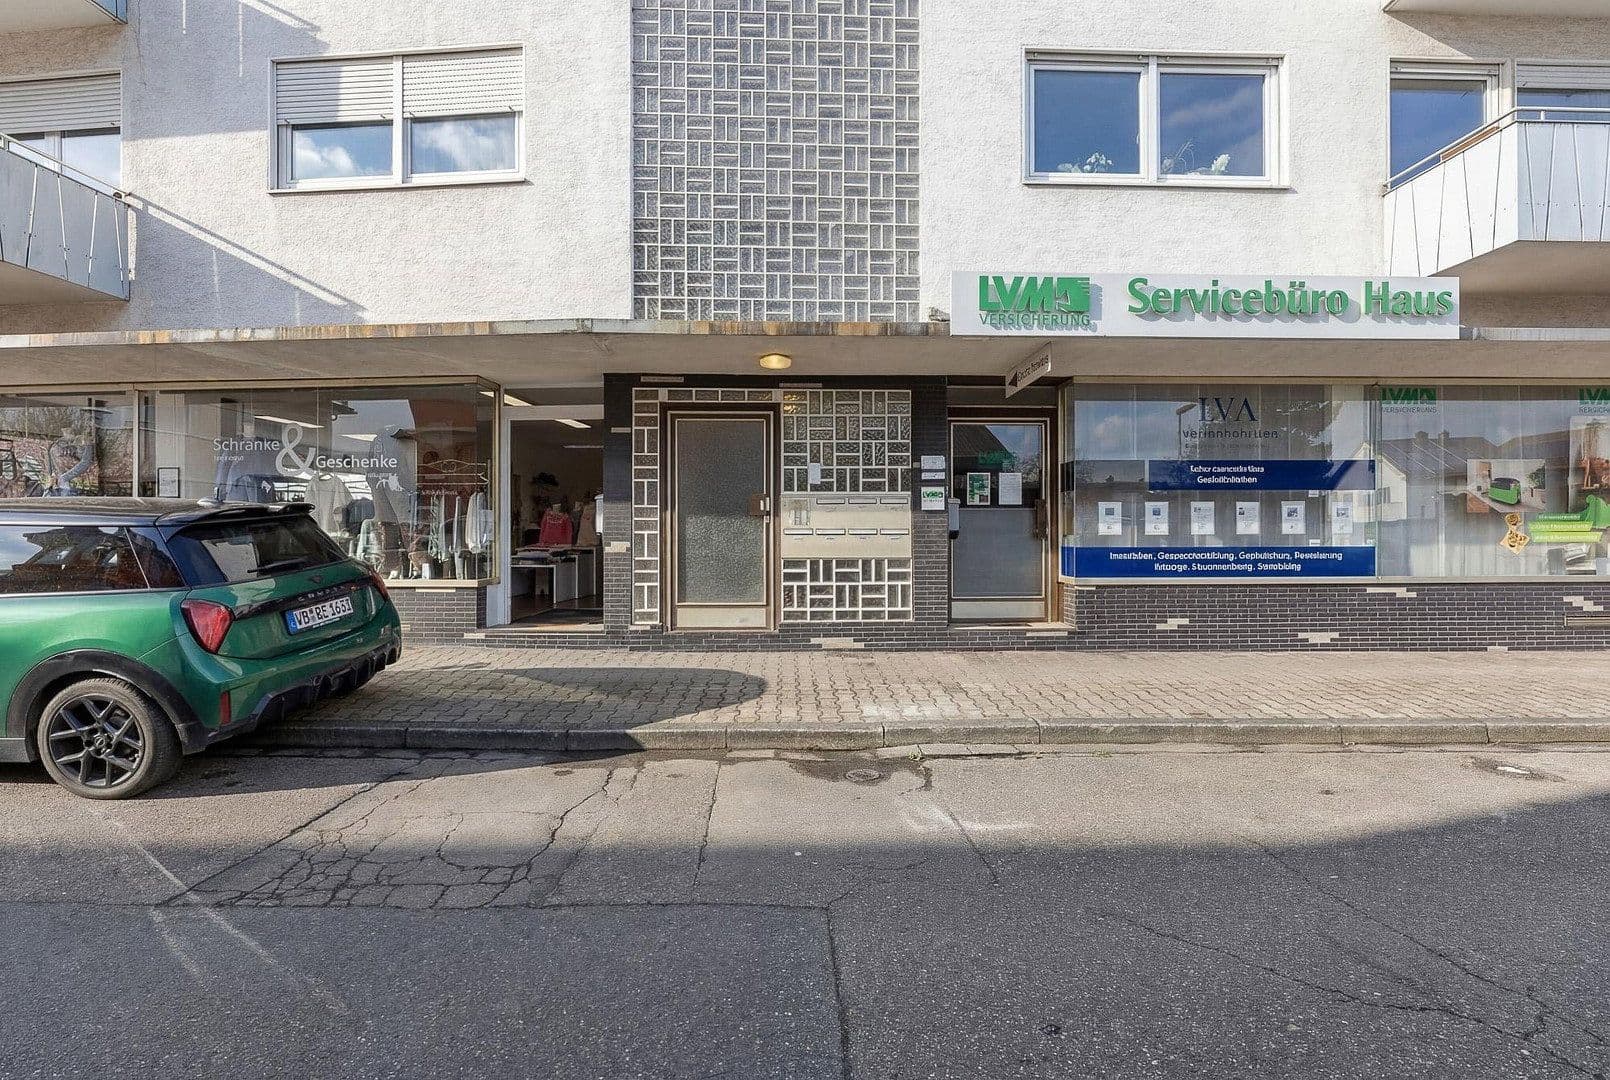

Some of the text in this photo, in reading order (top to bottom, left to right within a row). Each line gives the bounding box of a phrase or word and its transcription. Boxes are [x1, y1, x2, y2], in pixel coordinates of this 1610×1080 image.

[979, 276, 1054, 312] LVM
[1127, 277, 1455, 316] Servicebüro Haus
[979, 314, 1090, 326] VERSICHERUNG
[275, 423, 316, 476] &
[315, 455, 398, 468] Geschenke
[294, 609, 311, 626] VB
